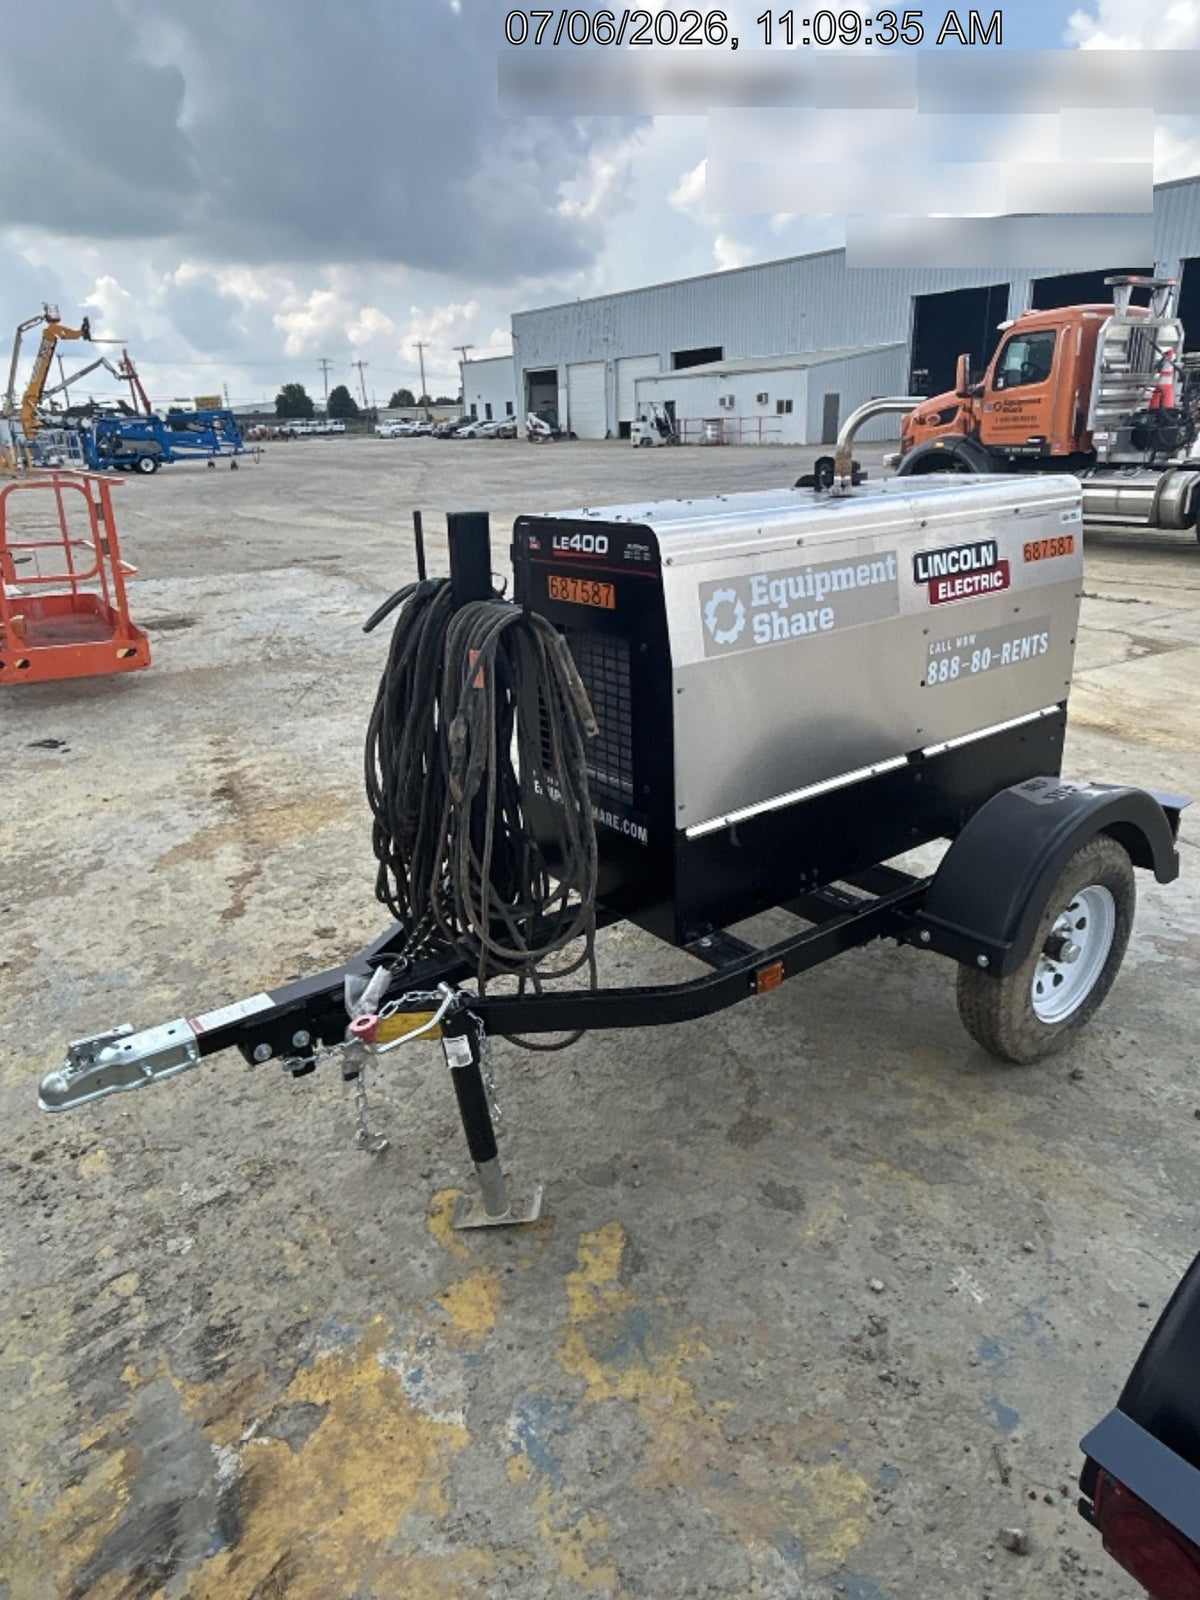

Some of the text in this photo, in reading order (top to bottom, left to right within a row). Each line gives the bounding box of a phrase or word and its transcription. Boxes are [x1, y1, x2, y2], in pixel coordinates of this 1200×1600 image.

[552, 533, 609, 554] LE400
[1023, 536, 1074, 562] 687587
[917, 544, 994, 579] LINCOLN
[550, 577, 614, 607] 687587
[750, 554, 897, 609] Equipment
[938, 570, 1004, 600] ELECTRIC
[752, 606, 835, 645] Share
[927, 632, 1049, 686] 888-80-RENTS
[929, 634, 977, 656] CALL NOW
